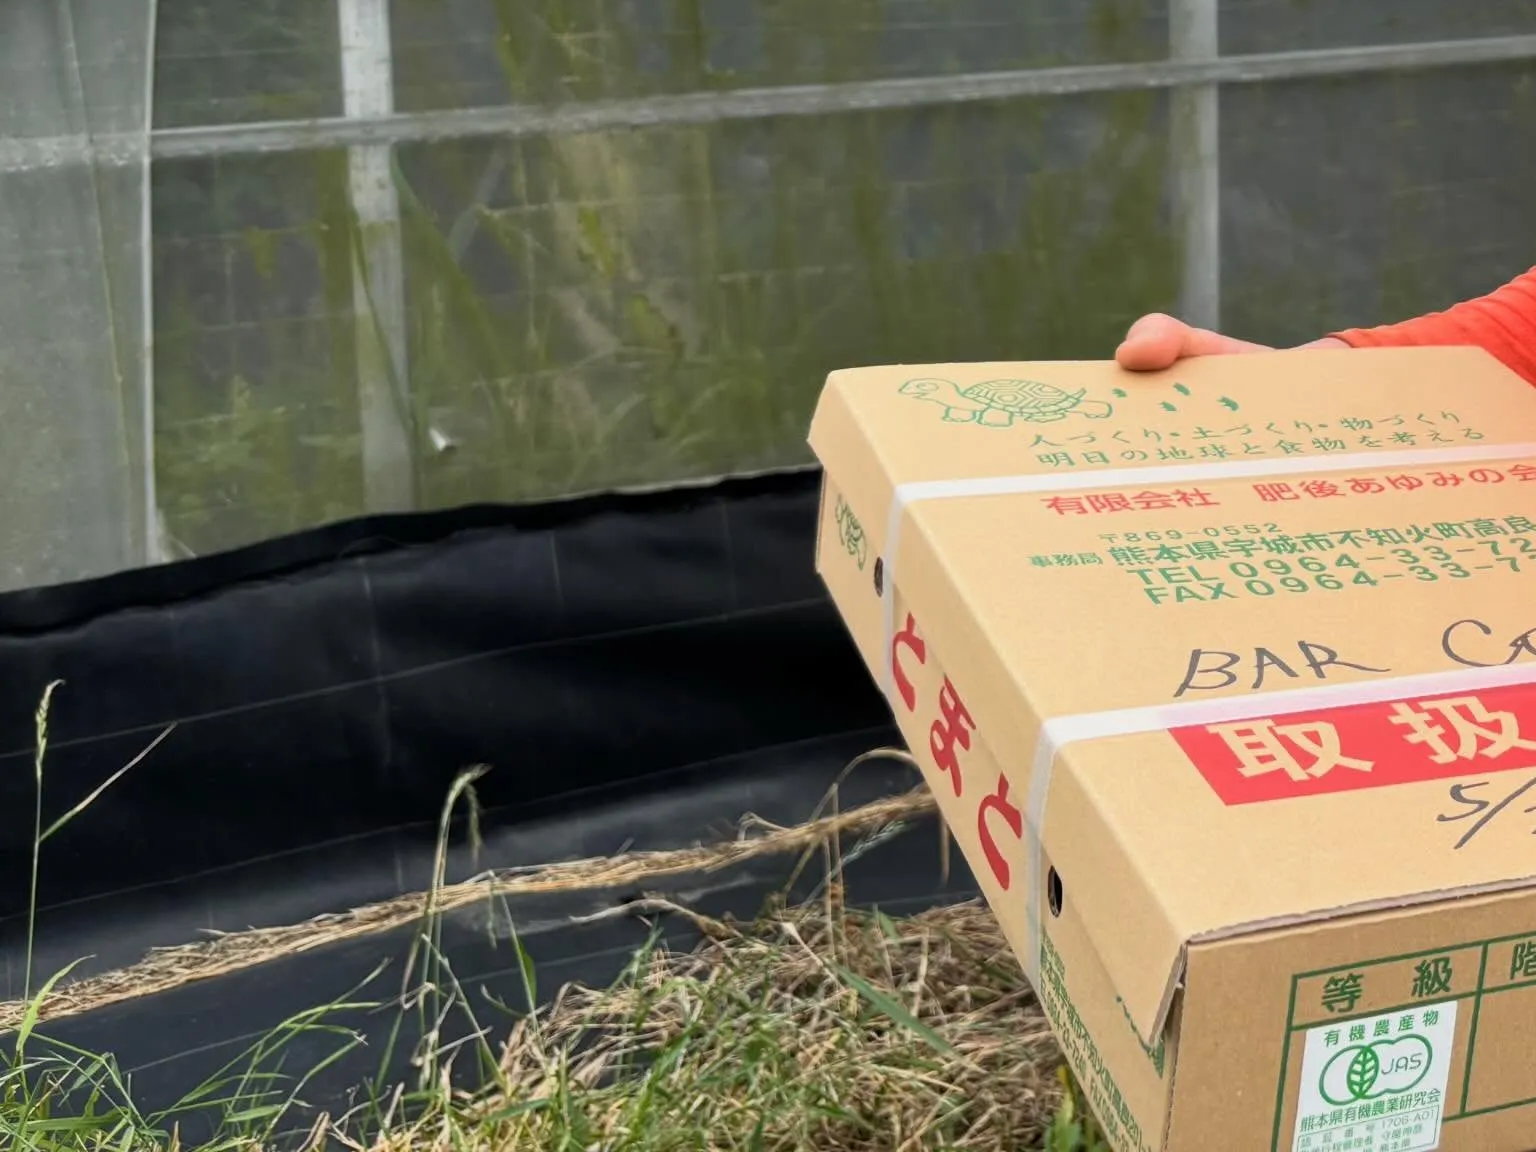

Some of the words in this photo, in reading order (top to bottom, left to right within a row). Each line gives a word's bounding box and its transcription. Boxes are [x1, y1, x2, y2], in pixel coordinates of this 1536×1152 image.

[1037, 427, 1485, 468] 明日の地球と食物を考える
[1041, 487, 1221, 515] 有限会社
[1127, 564, 1220, 586] TEL
[1144, 582, 1240, 606] FAX
[1173, 639, 1391, 697] BAR
[892, 611, 1022, 891] とまと
[1323, 1009, 1440, 1048] 有機農産物
[1381, 1052, 1423, 1075] JAS
[1300, 1088, 1442, 1132] 熊本県有機農業研究会
